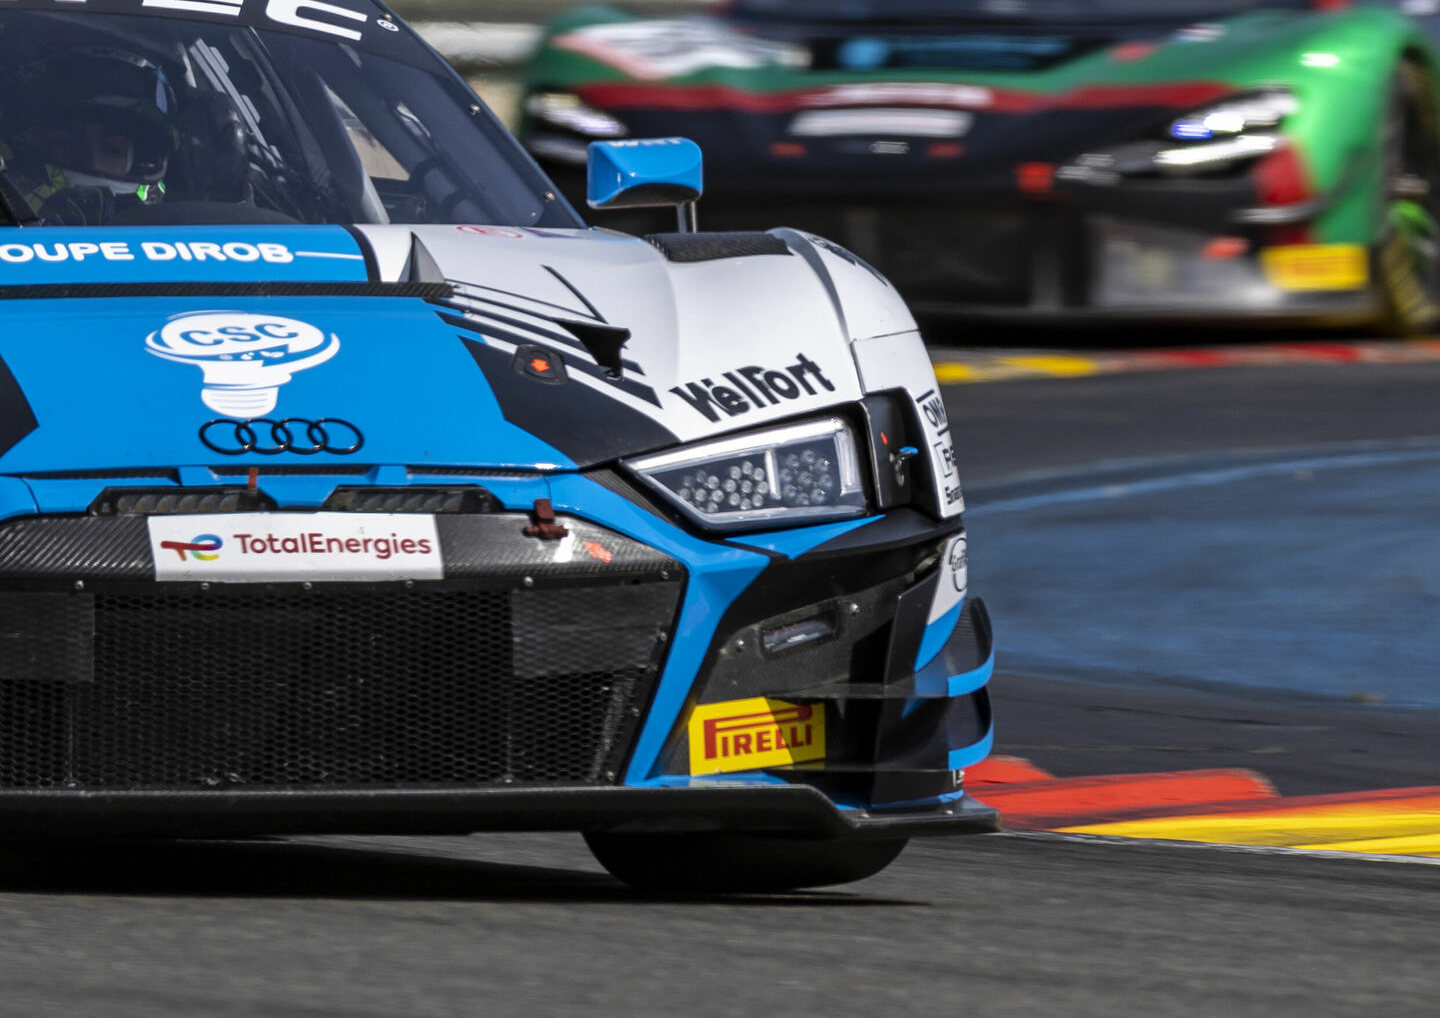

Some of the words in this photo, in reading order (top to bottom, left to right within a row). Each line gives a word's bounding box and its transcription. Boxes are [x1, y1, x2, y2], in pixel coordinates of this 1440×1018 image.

[140, 241, 294, 264] DIROB
[179, 322, 300, 347] CSC
[232, 532, 432, 560] TotalEnergies
[703, 705, 813, 760] PIRELLI
